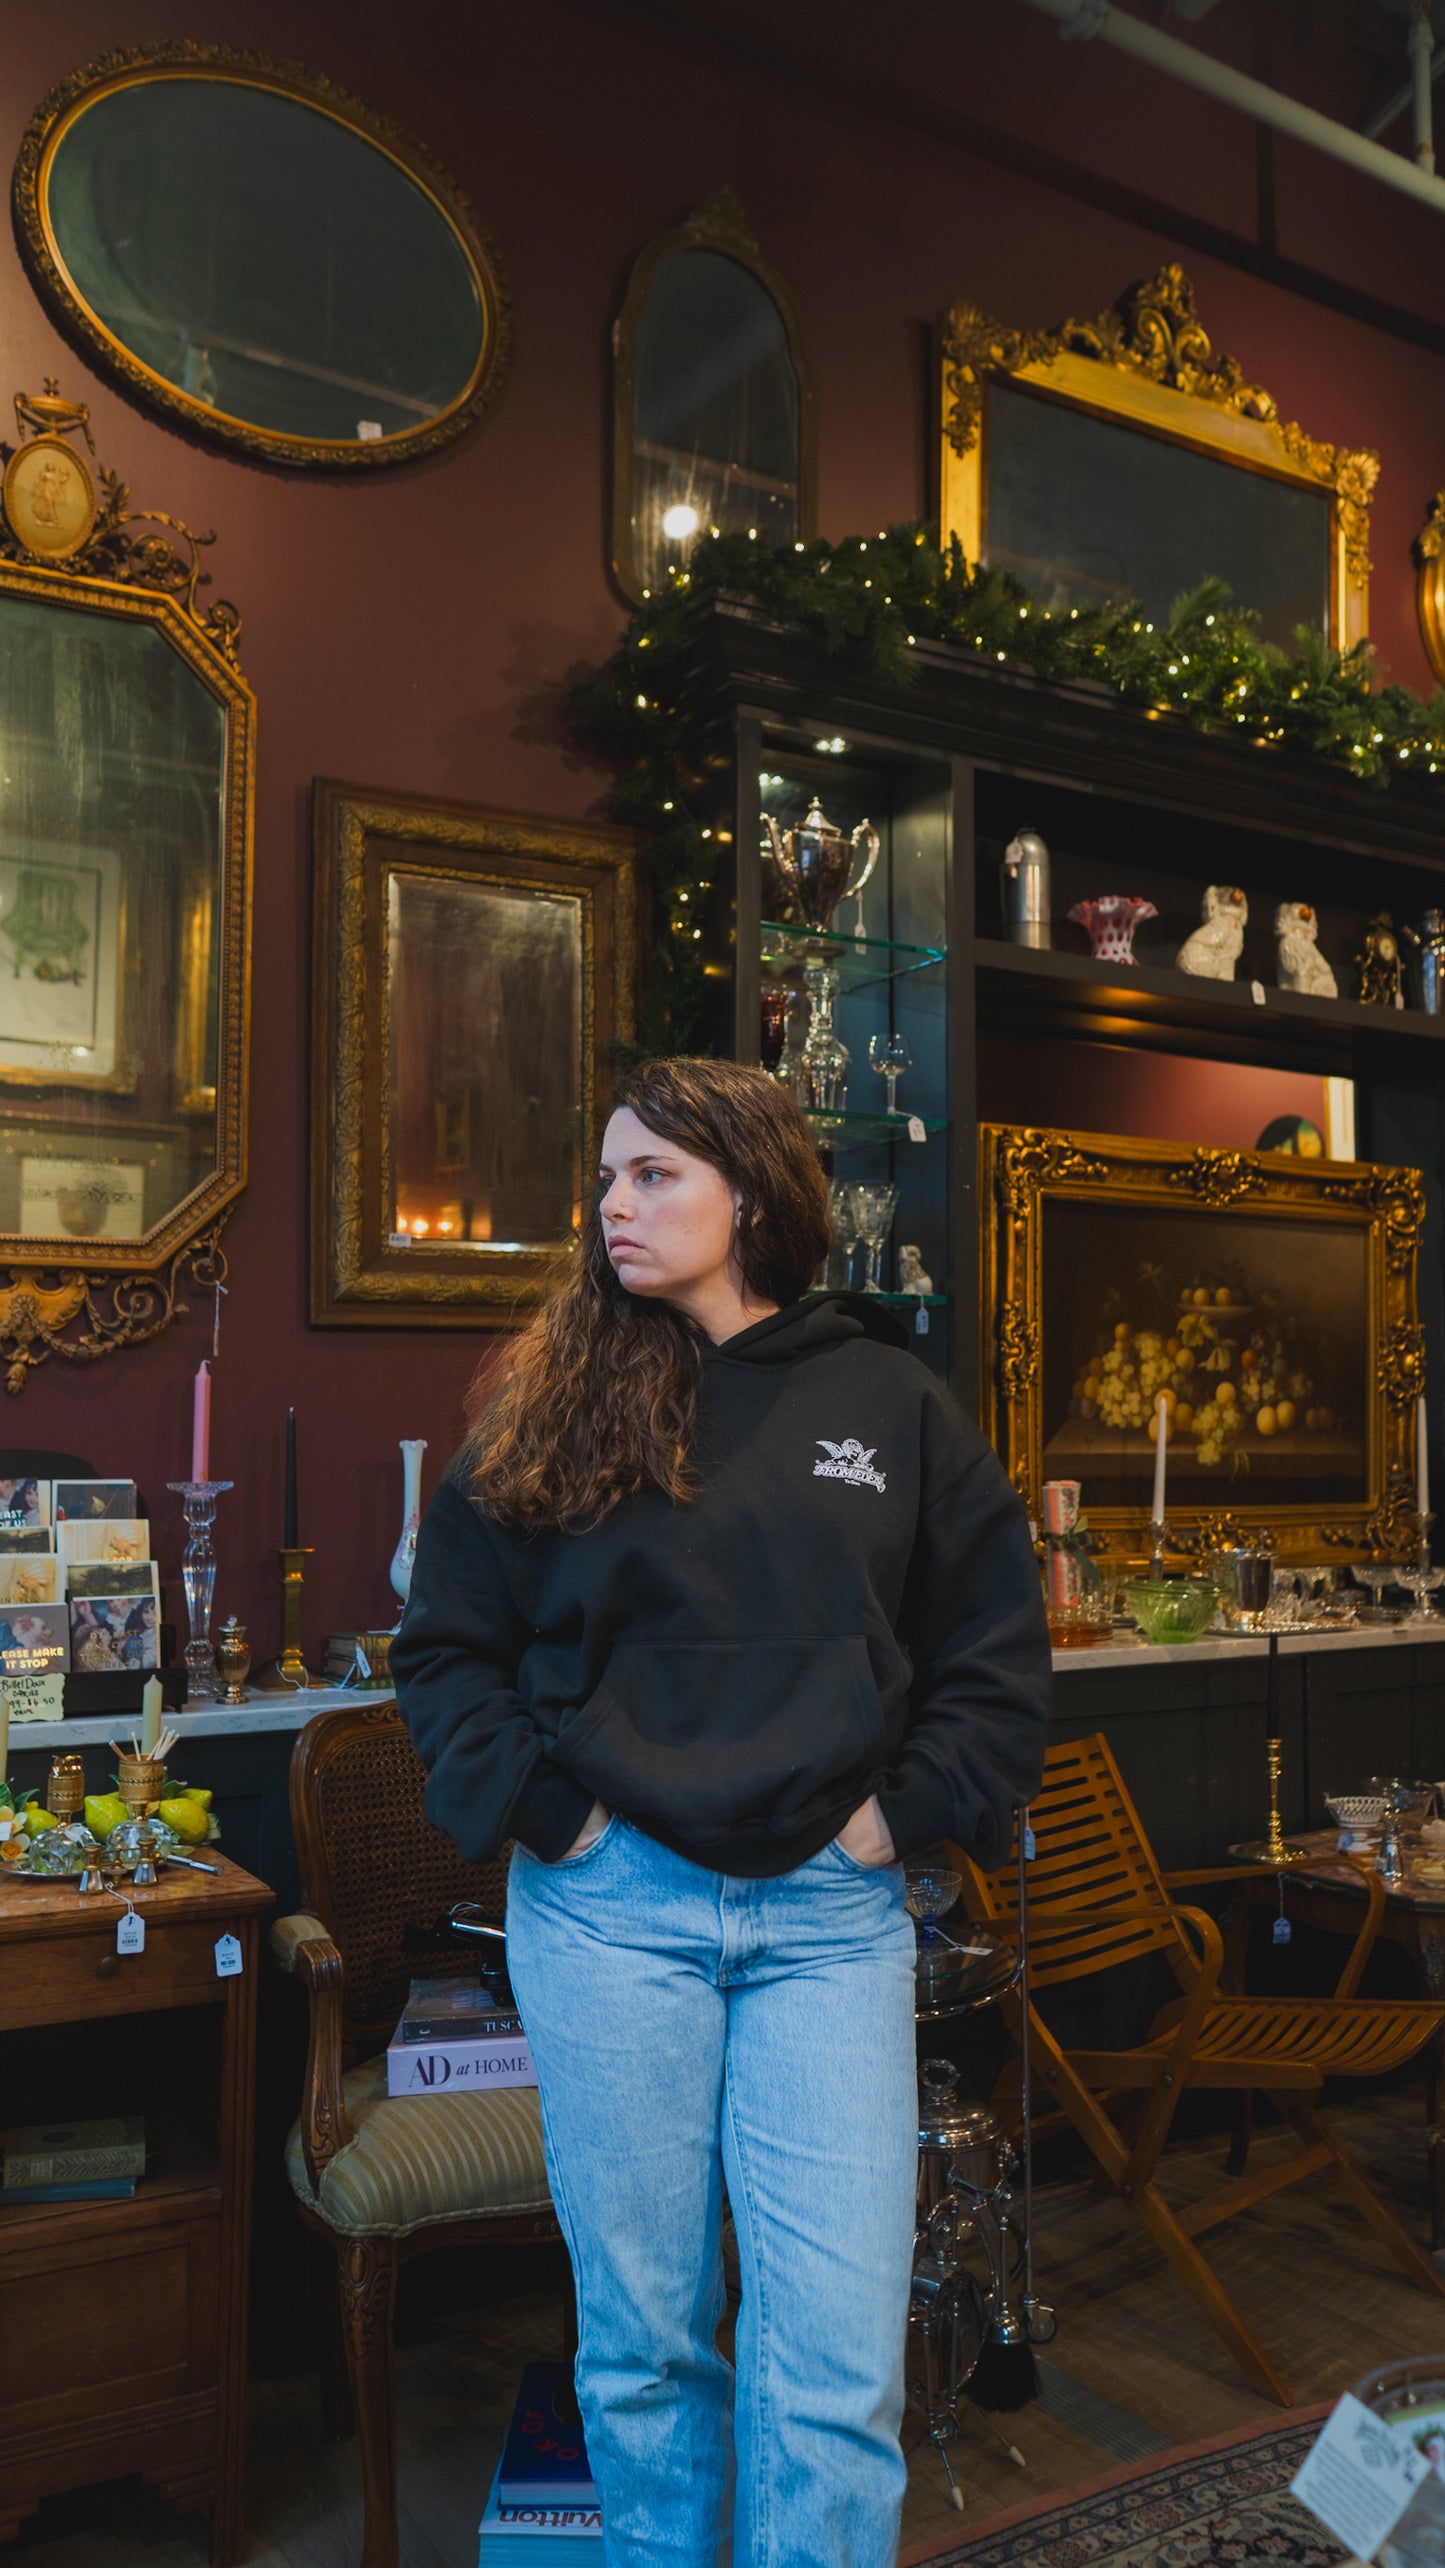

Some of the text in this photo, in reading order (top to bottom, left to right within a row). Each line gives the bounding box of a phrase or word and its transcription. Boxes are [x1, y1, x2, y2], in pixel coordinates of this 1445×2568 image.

[0, 1647, 64, 1659] EASE MAKE
[6, 1658, 48, 1669] IT STOP
[408, 2055, 528, 2088] AD at HOME
[499, 2509, 602, 2528] Vuitton
